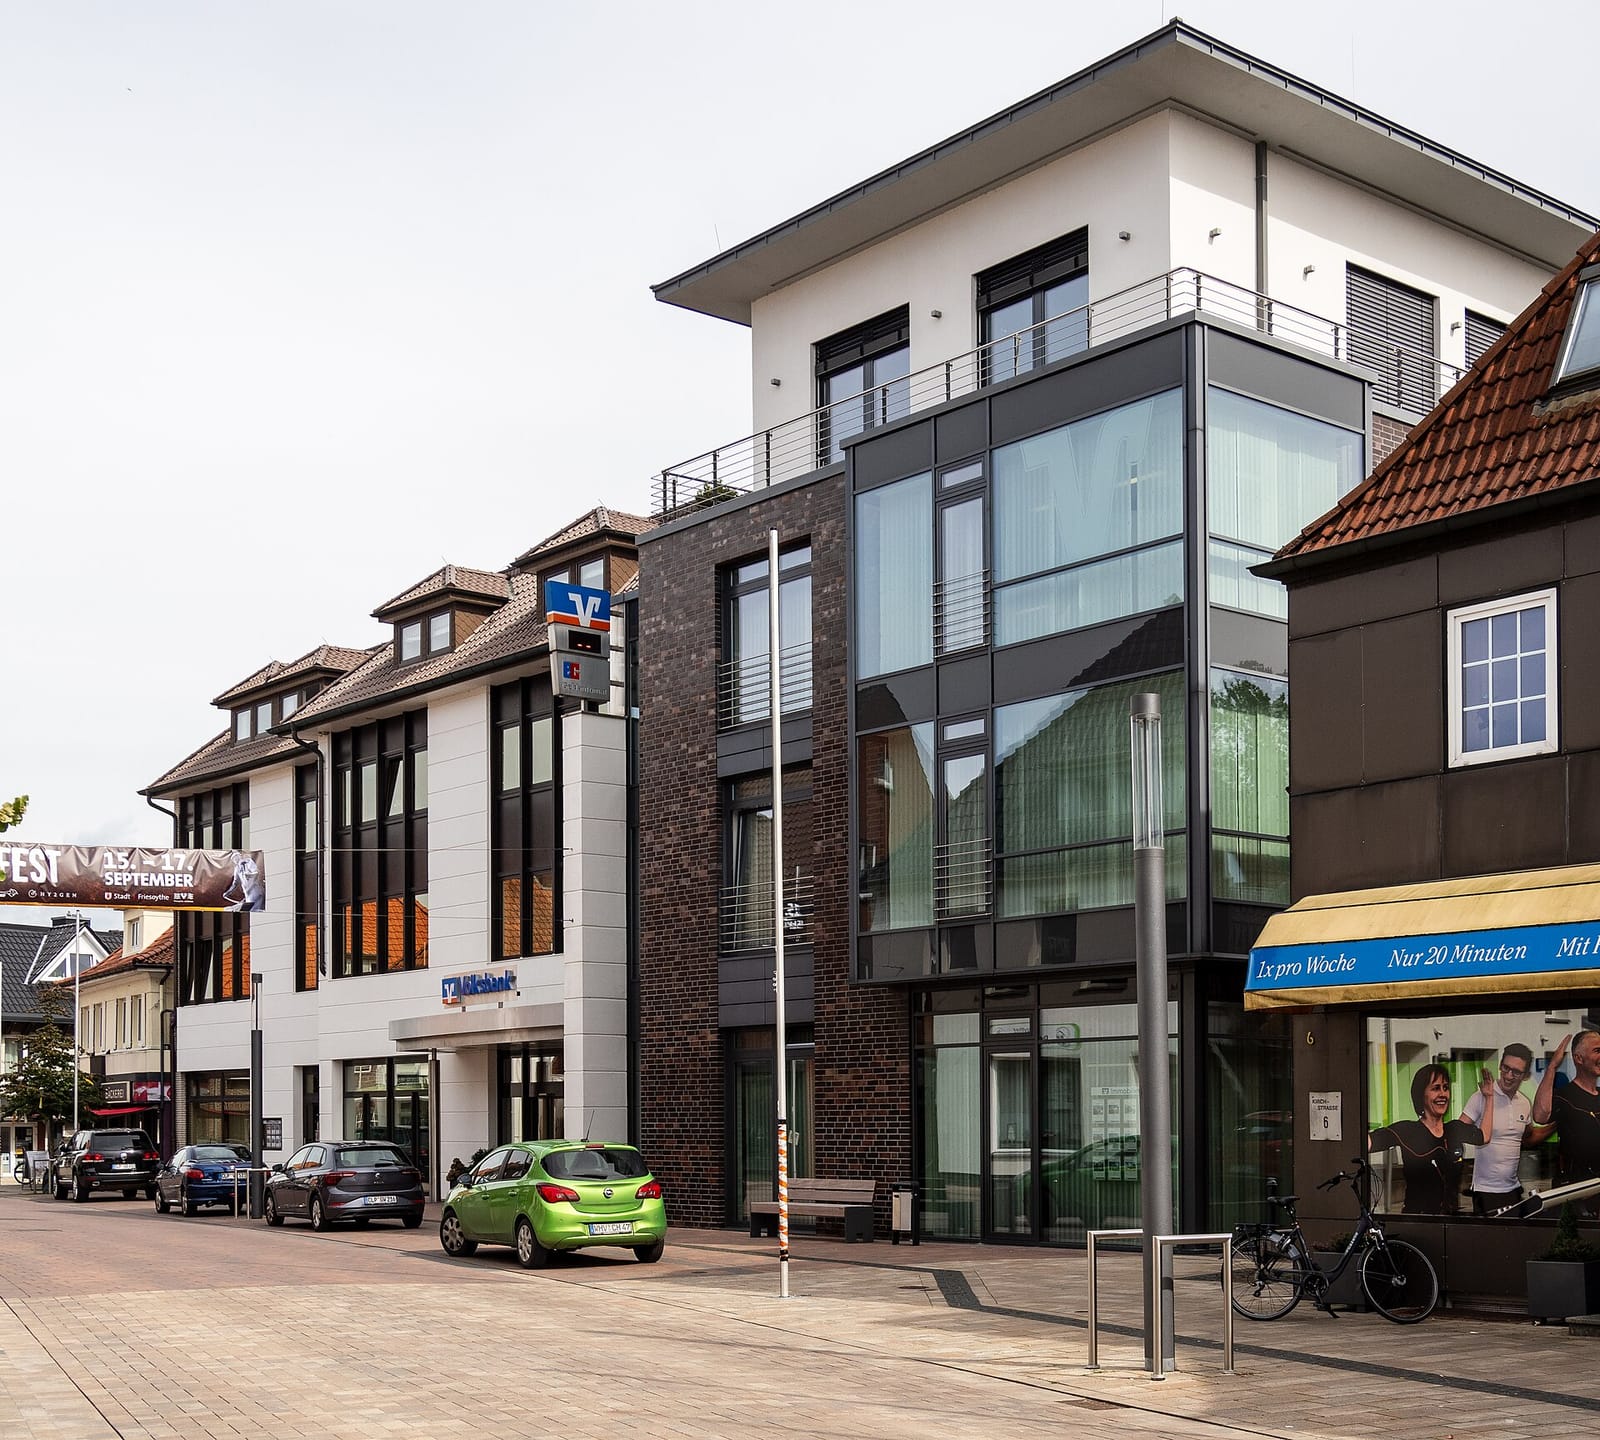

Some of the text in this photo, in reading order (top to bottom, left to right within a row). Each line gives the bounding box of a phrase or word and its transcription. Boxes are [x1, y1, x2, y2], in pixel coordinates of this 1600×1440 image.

[103, 852, 136, 870] 15.
[161, 854, 193, 871] 17.
[104, 871, 194, 887] SEPTEMBER
[113, 892, 131, 900] Stadt
[137, 892, 170, 902] Friesoythe
[1555, 936, 1591, 958] Mit
[1387, 944, 1527, 968] Nur 20 Minuten
[1274, 962, 1302, 981] pro
[1306, 953, 1357, 975] Woche
[459, 969, 514, 995] Volksbank
[1306, 1031, 1314, 1045] 6
[1323, 1115, 1329, 1129] 6
